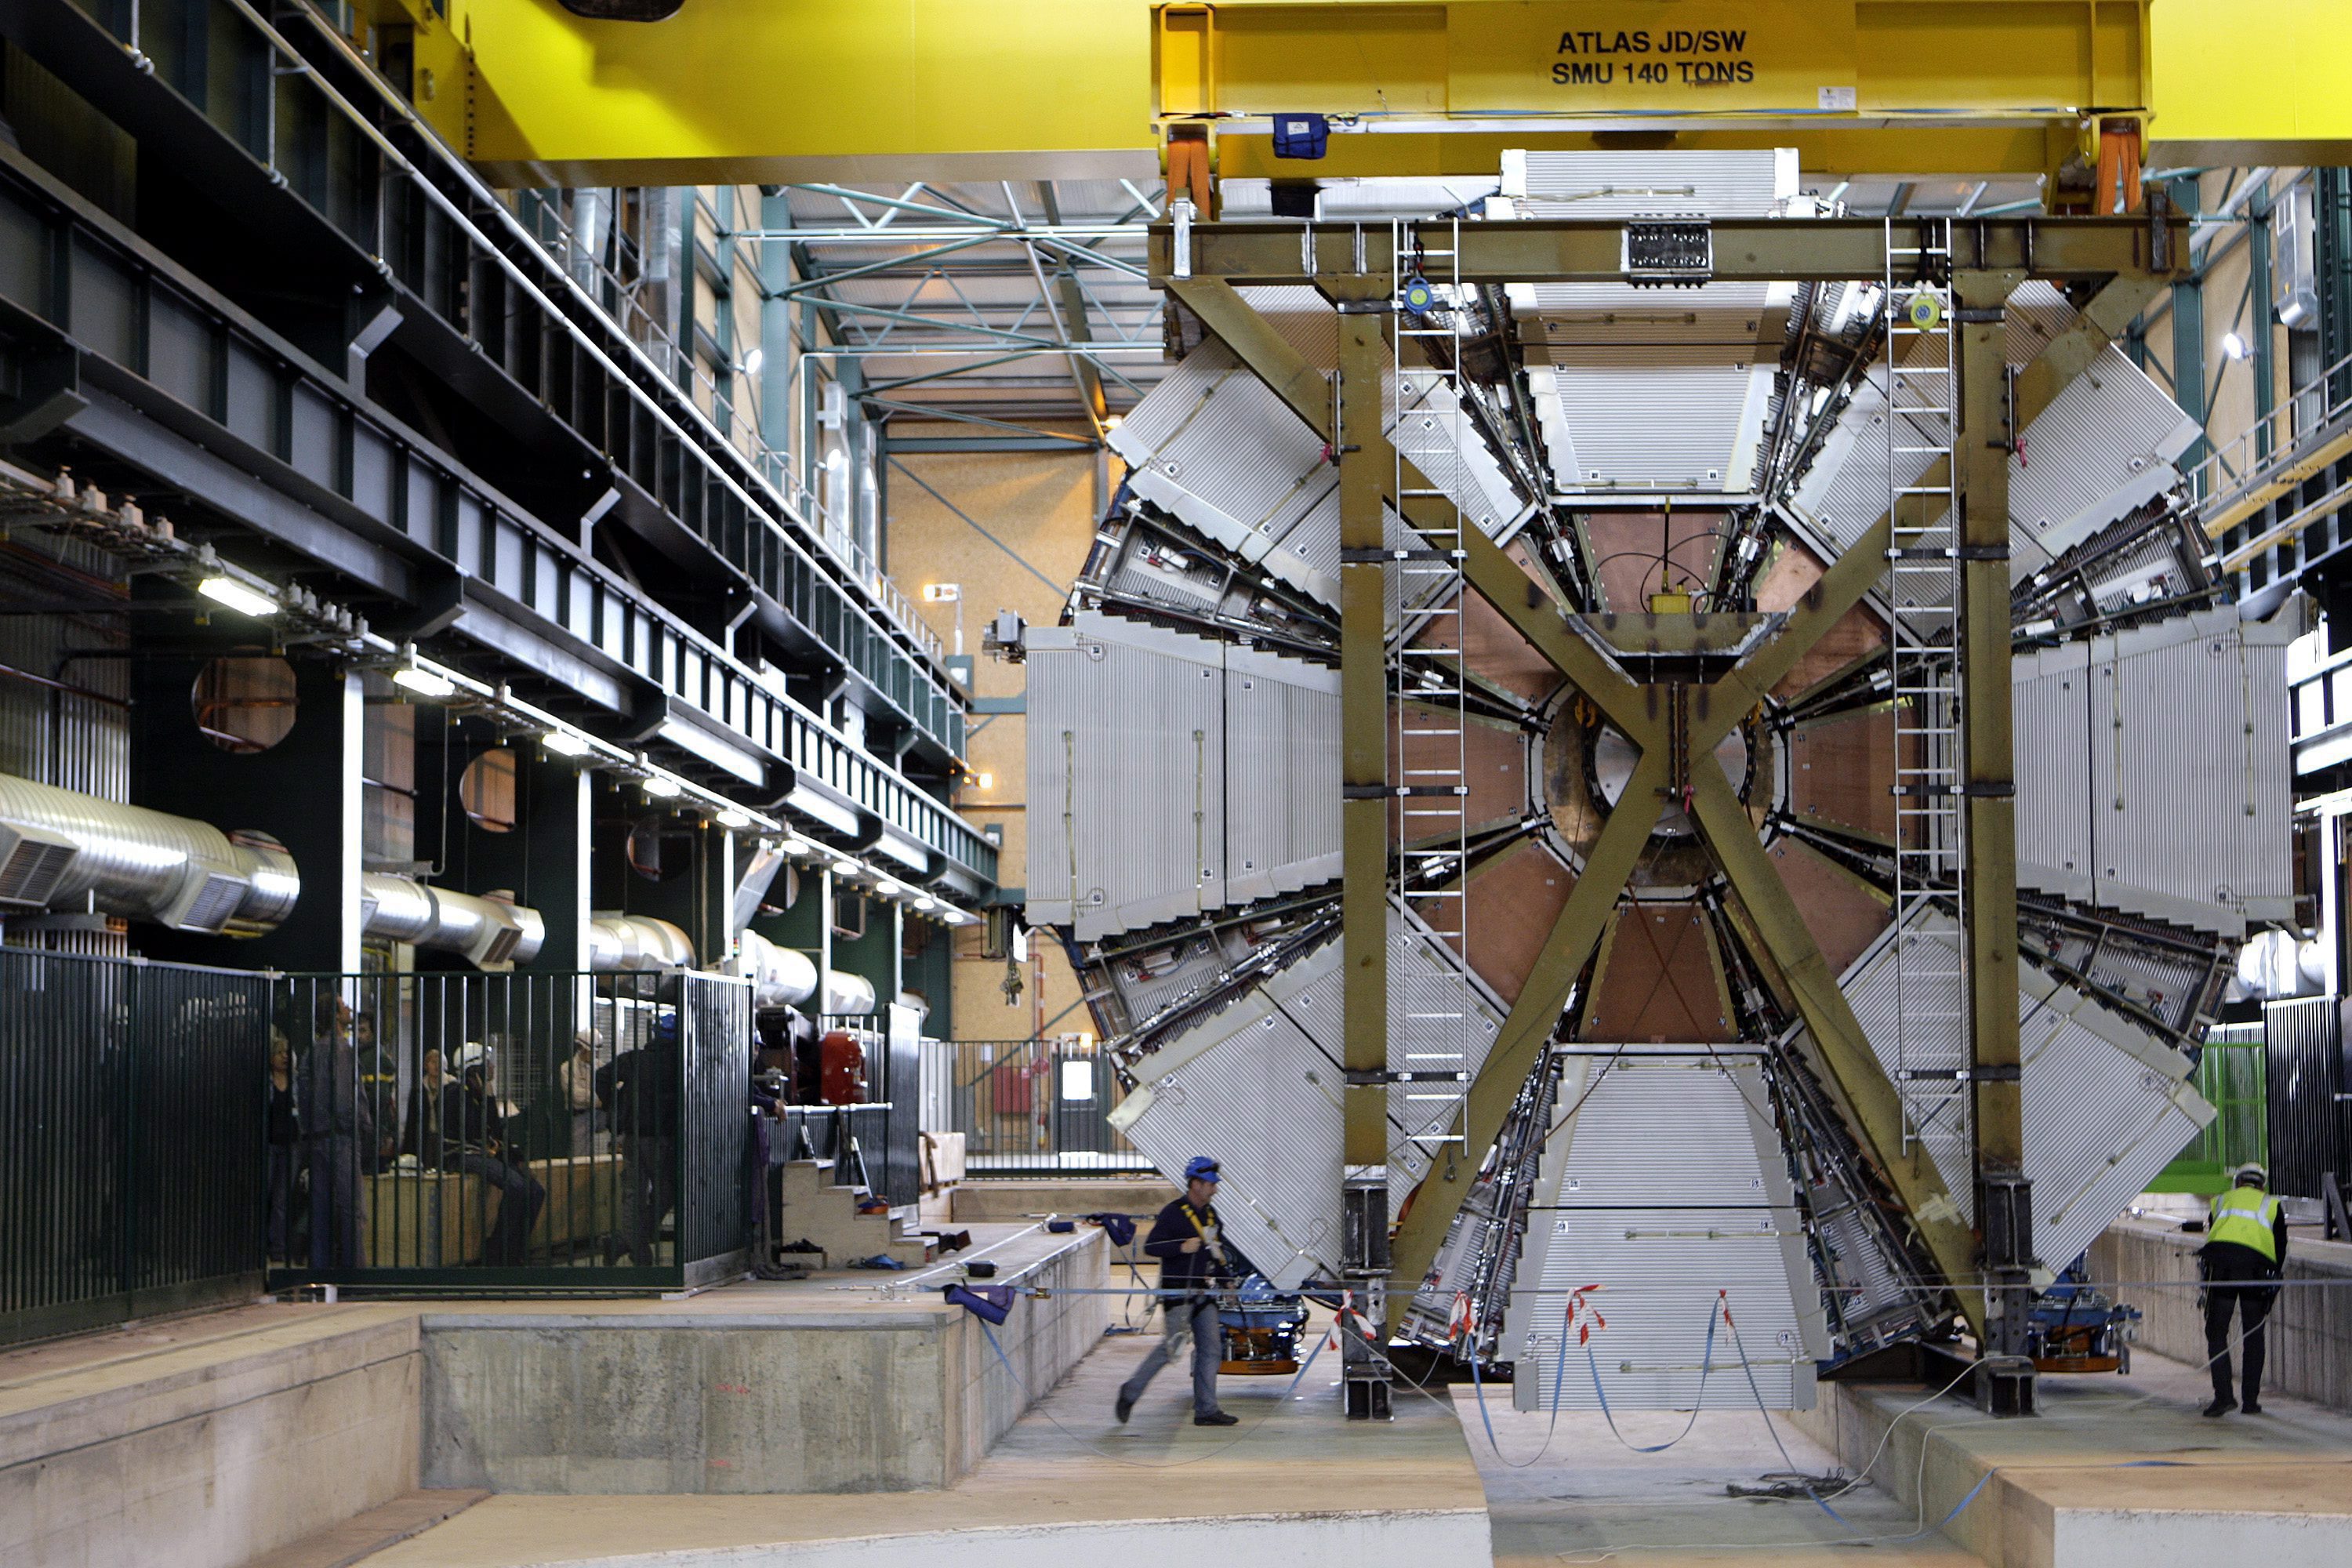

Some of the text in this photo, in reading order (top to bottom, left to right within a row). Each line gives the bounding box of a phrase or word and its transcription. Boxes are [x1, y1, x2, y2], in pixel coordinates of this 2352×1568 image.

[1557, 30, 1747, 54] ATLAS JD/SW
[1552, 60, 1754, 84] SMU 140 TONS
